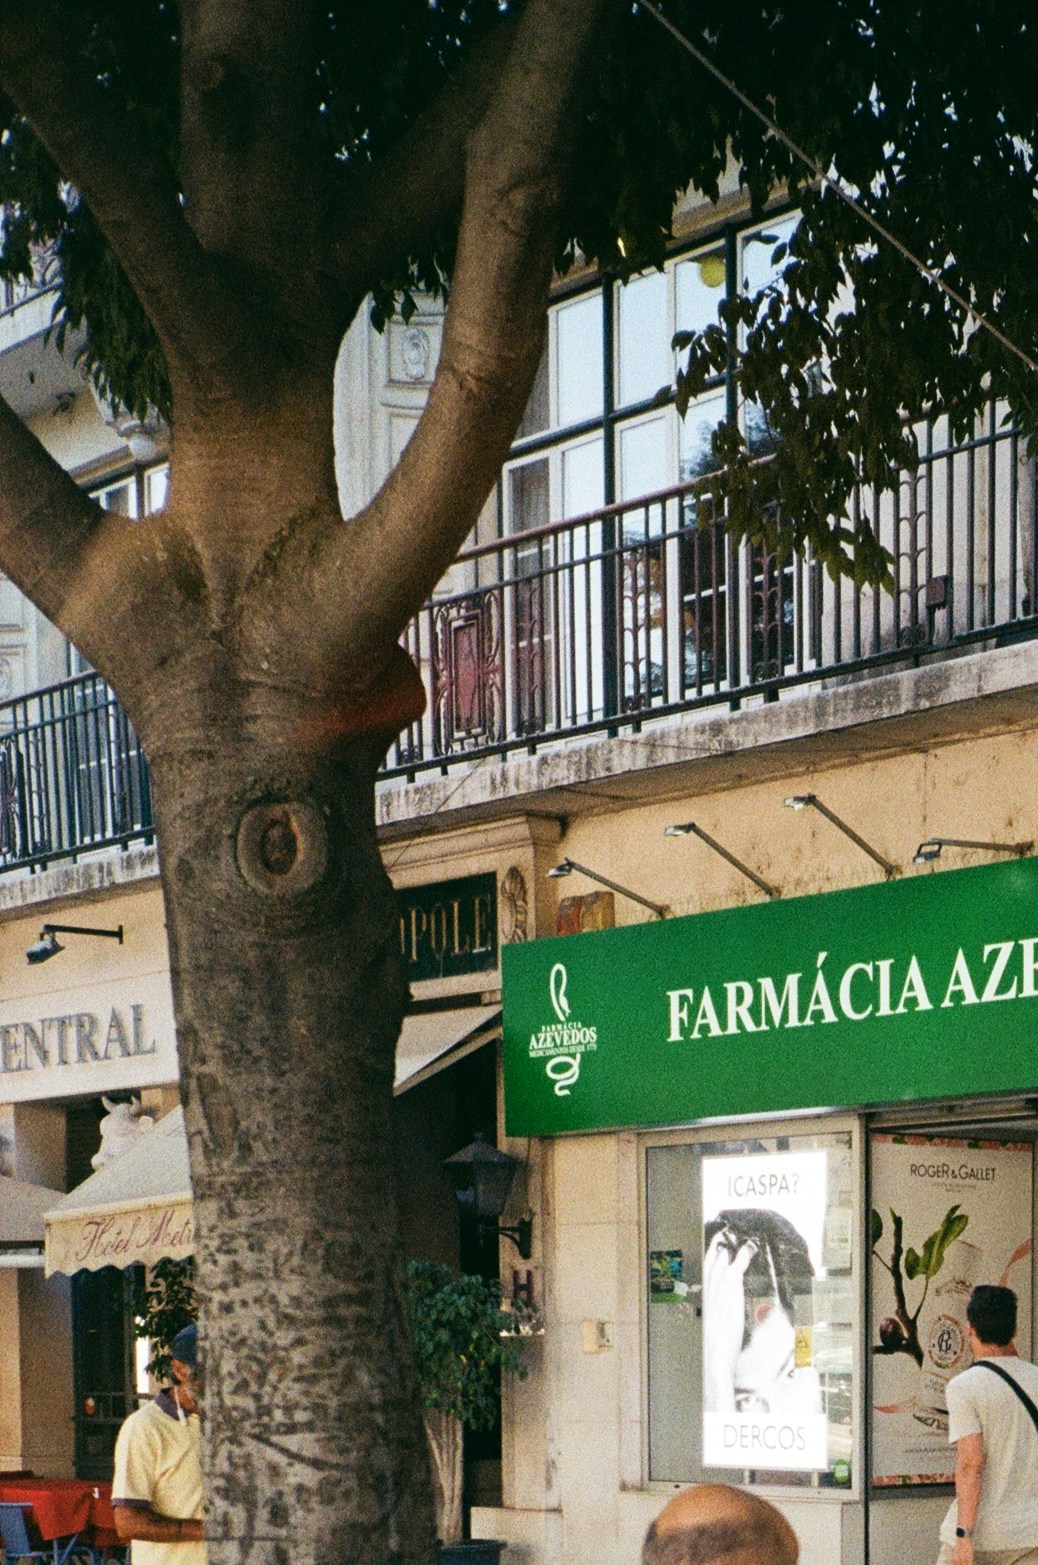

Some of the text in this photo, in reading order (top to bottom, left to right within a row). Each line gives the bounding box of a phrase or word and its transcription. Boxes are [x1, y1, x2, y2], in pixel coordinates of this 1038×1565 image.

[666, 951, 934, 1042] FARMÁCIA
[0, 1003, 157, 1074] ENTRAL
[528, 1026, 598, 1051] AZEVEDOS
[75, 1216, 142, 1262] Hotel
[723, 1424, 807, 1451] DERCOS
